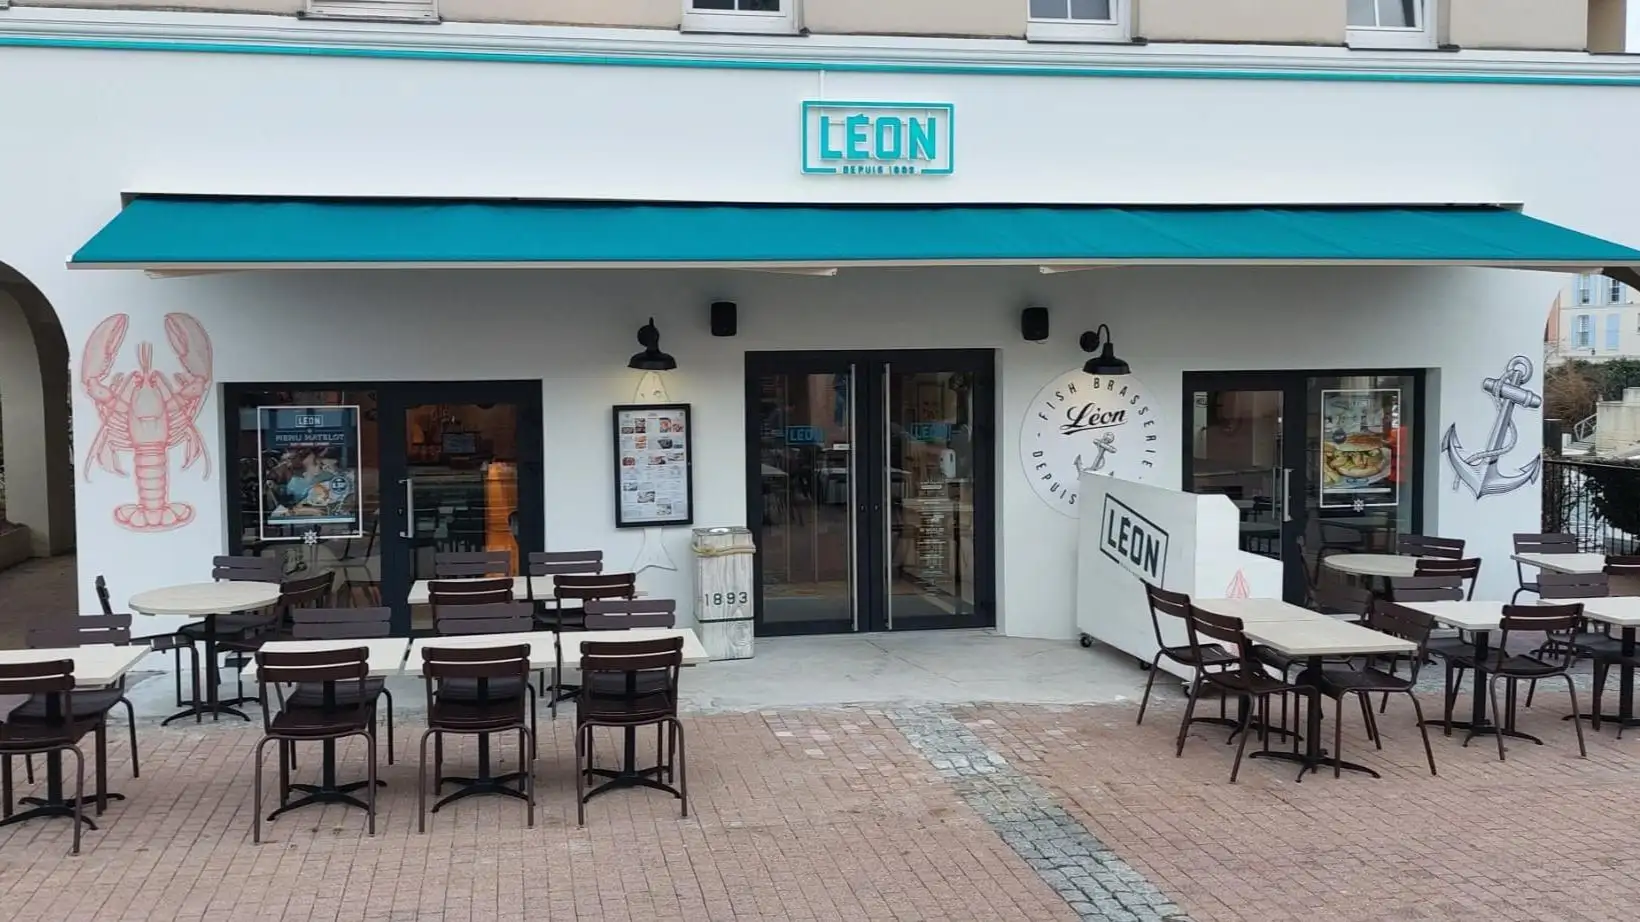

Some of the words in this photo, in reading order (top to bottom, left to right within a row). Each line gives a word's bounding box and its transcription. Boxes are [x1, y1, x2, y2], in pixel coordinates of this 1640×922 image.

[820, 114, 936, 160] LÉON
[843, 165, 884, 175] DEPUIS
[1038, 382, 1077, 421] FISH
[1093, 377, 1157, 468] BRASSERIE
[1059, 402, 1128, 436] Léon
[275, 434, 302, 442] MENU
[304, 433, 345, 441] MATELOT
[1032, 450, 1077, 505] DEPUIS
[704, 591, 749, 607] 1893
